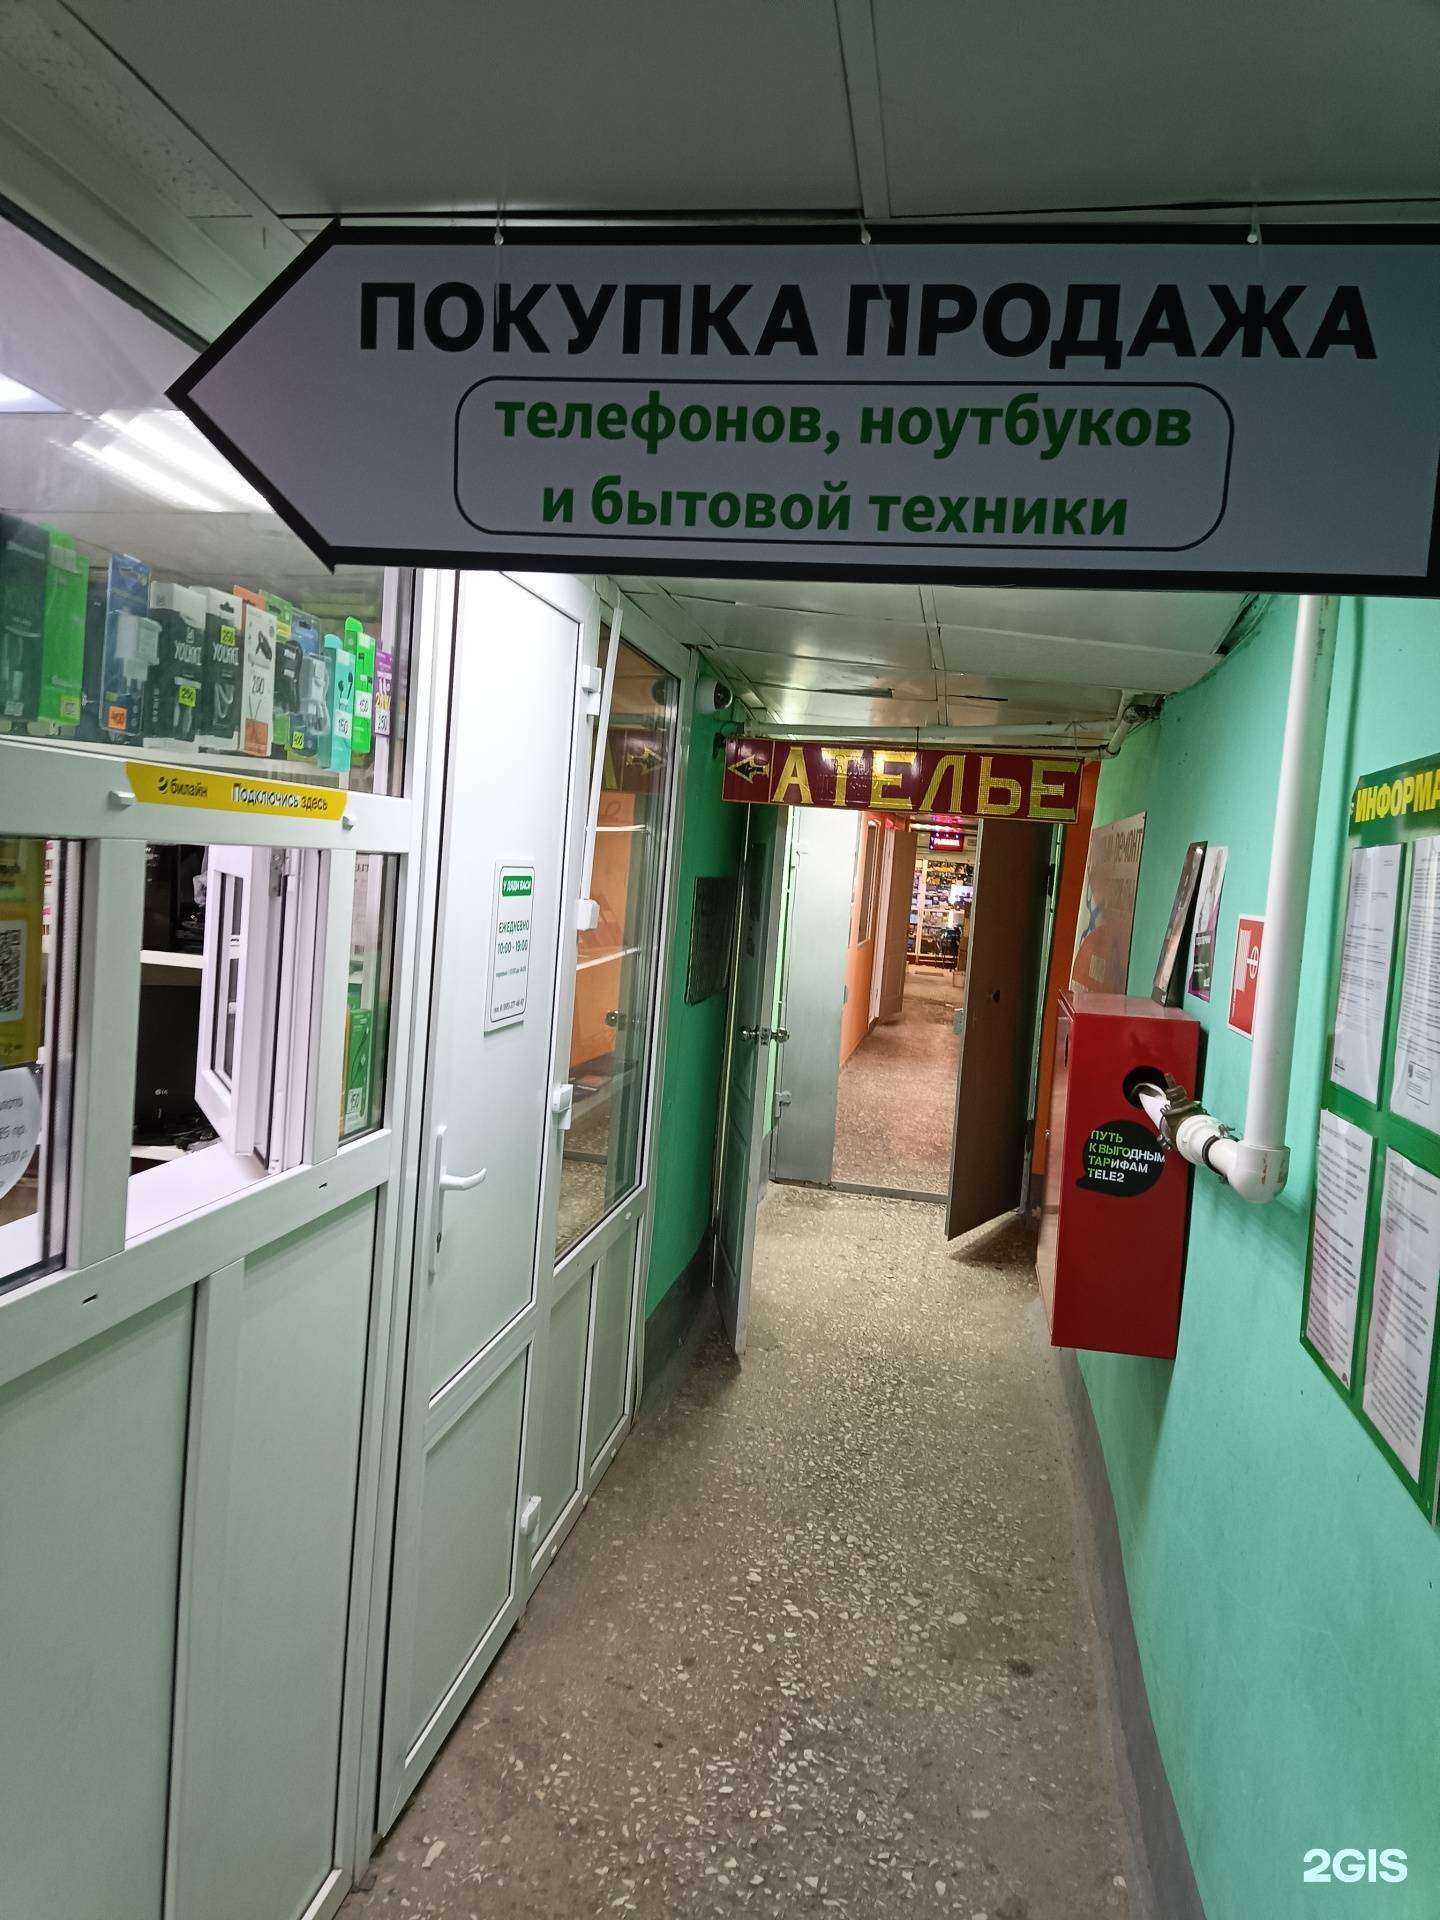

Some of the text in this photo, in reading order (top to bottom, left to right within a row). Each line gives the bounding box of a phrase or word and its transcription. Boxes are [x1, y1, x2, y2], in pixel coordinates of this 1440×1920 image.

[359, 281, 1379, 370] ПОКУПКА ПРОДАЖА
[495, 390, 1193, 460] телефонов, ноутбуков
[541, 474, 1129, 538] и бытовой техники
[170, 777, 328, 812] билайн Подключись здесь
[770, 745, 1080, 821] АТЕЛЬЕ
[1088, 1142, 1166, 1163] К ВЫГОДНЫМ
[1090, 1130, 1123, 1143] ПУТЬ
[1087, 1167, 1125, 1183] TELE2
[1088, 1155, 1149, 1174] ТАРИФАМ
